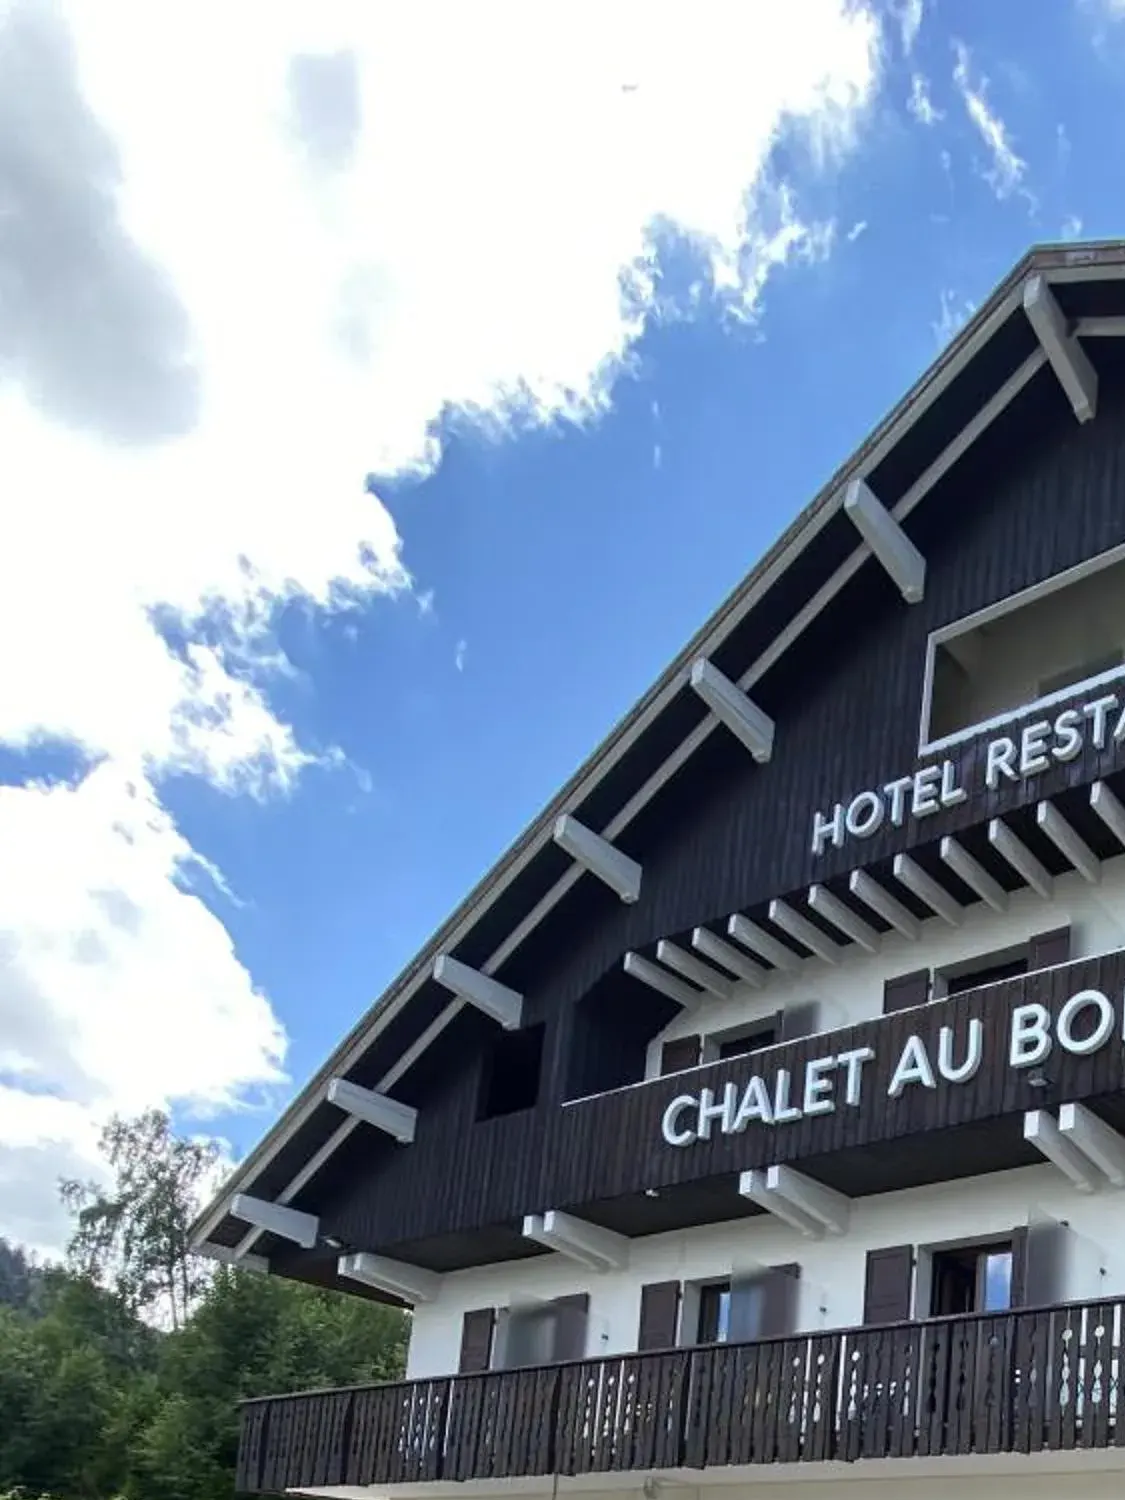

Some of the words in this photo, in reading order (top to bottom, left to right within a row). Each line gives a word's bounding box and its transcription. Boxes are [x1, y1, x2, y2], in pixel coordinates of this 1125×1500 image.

[811, 760, 967, 853] HOTEL
[662, 1047, 875, 1147] CHALET
[888, 1020, 983, 1098] AU
